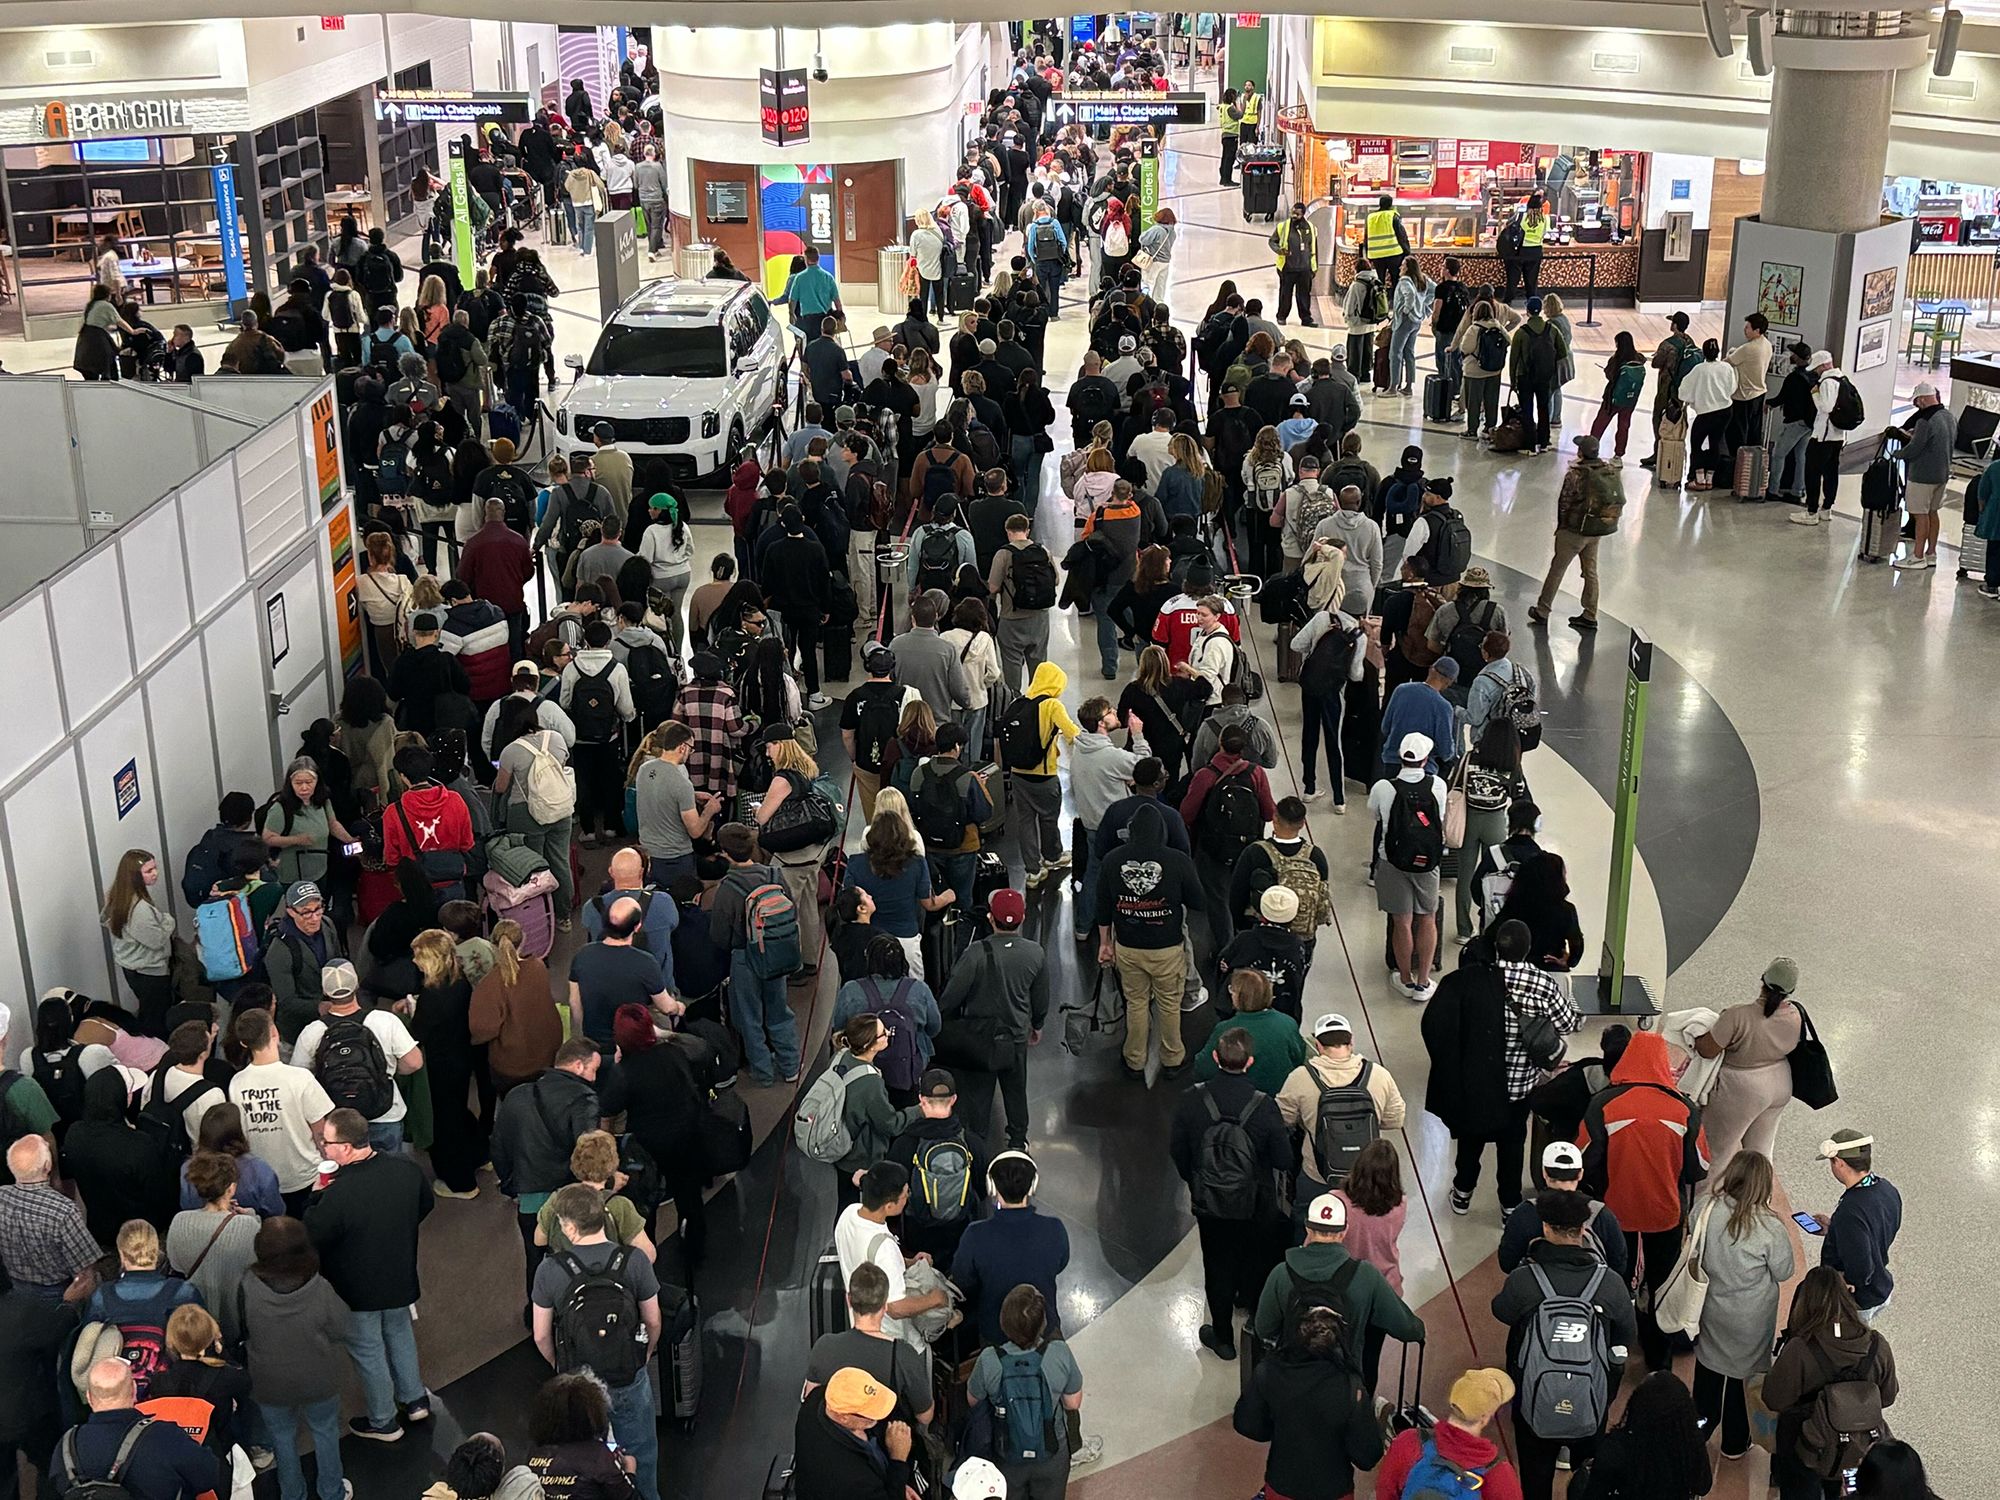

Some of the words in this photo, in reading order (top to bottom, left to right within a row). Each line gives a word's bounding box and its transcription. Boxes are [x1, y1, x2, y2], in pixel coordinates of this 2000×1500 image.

[323, 16, 343, 30] EXIT
[420, 105, 444, 115] Main
[445, 104, 502, 117] Checkpoint
[1095, 105, 1118, 116] Main
[1120, 105, 1178, 118] Checkpoint
[454, 172, 466, 205] Gates
[1142, 172, 1153, 206] Gates
[223, 184, 233, 226] Assistance
[455, 212, 467, 224] All
[1142, 210, 1153, 224] All
[229, 228, 237, 258] Special
[1181, 612, 1198, 624] LEO
[1625, 714, 1633, 762] Gates
[1118, 895, 1140, 903] THE
[1133, 909, 1173, 918] AMERICA
[241, 1088, 279, 1100] TRUST
[258, 1100, 282, 1111] THE
[250, 1112, 278, 1124] LORD
